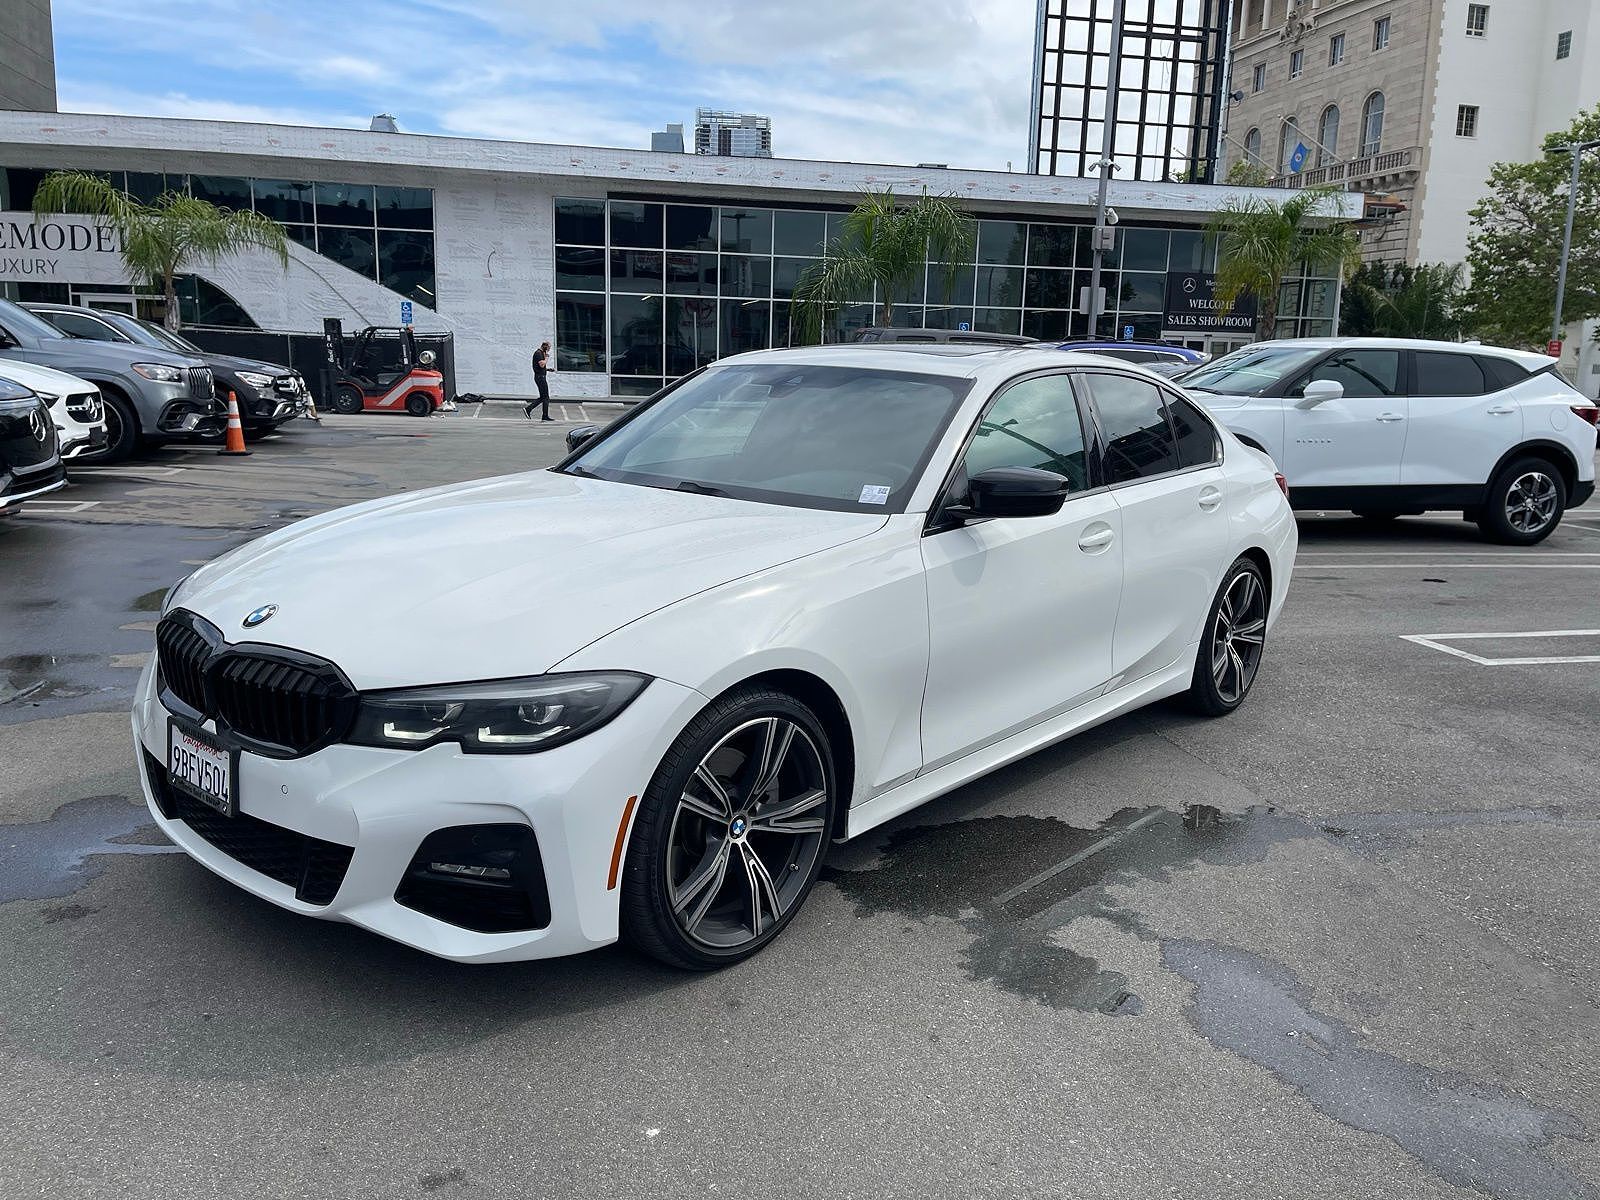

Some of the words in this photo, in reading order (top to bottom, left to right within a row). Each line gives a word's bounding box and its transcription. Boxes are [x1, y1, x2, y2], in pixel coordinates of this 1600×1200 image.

[1167, 315, 1197, 326] SALES
[1198, 316, 1252, 327] SHOWROOM
[172, 745, 229, 802] 9BFV504
